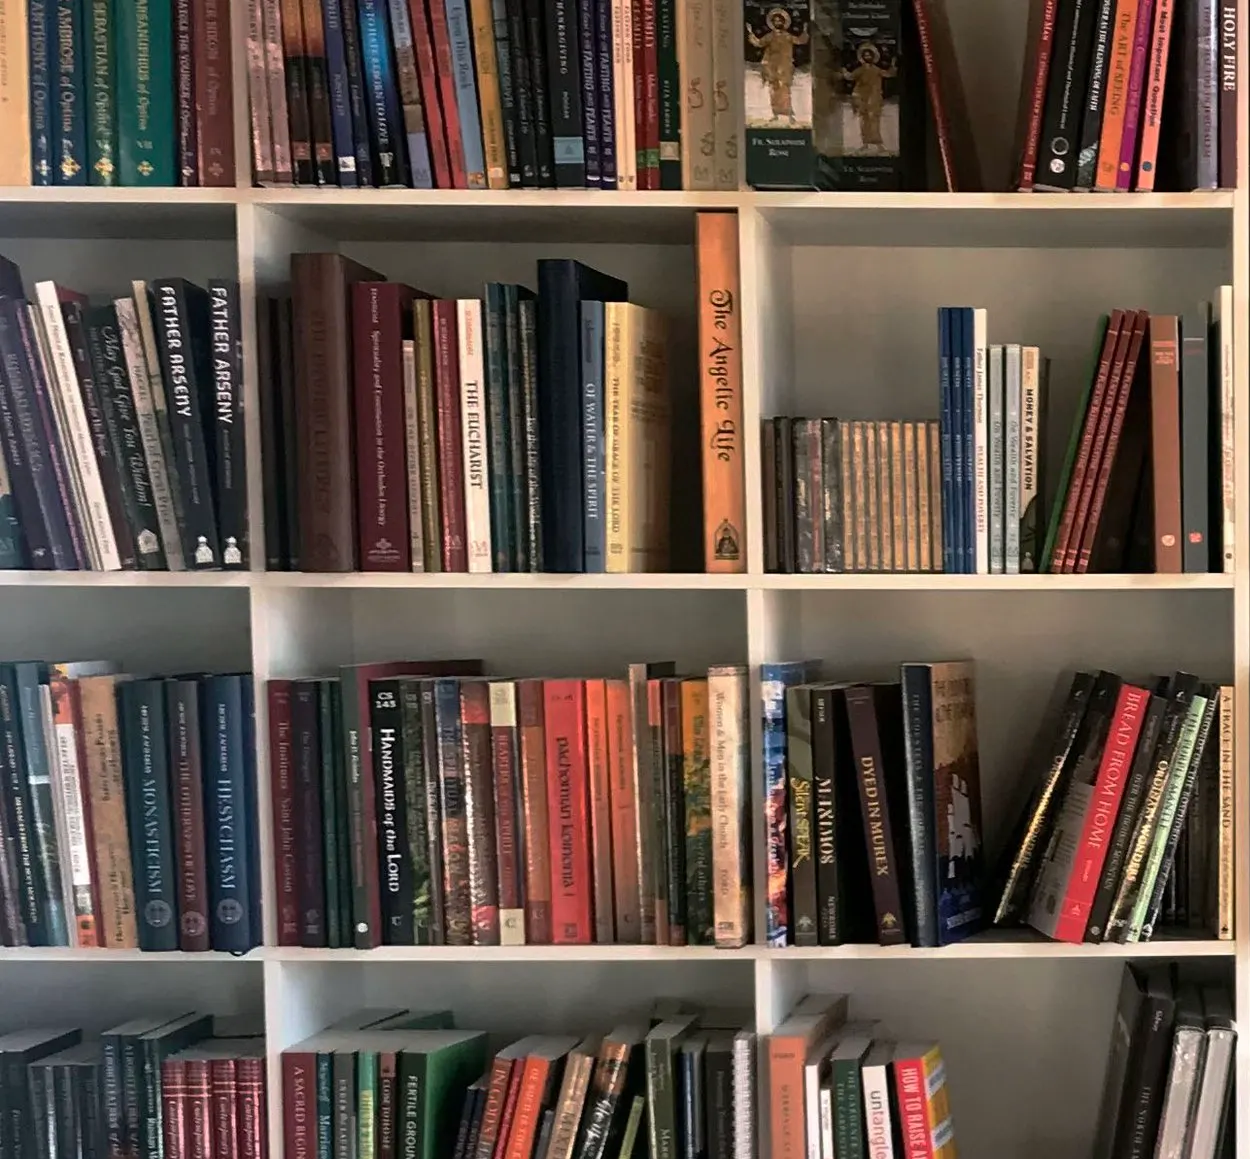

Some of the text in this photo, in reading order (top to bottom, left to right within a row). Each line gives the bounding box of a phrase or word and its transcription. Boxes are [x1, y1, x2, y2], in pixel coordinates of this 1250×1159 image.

[57, 7, 76, 132] AMBROSE of Optina
[1110, 13, 1130, 115] The ART of SEEING
[1223, 7, 1236, 91] HOLY FIRE
[212, 287, 229, 352] FATHER
[109, 366, 123, 390] God
[216, 359, 232, 424] ARSENY
[709, 289, 736, 462] The Angelic Life
[1025, 389, 1034, 424] MONEY
[465, 380, 482, 489] THE EUCHARIST
[1087, 693, 1141, 848] BREAD FROM HOME
[217, 779, 235, 888] HESYCHASM
[383, 814, 394, 826] of
[385, 829, 396, 851] the
[861, 757, 888, 876] DYED IN MUREX
[406, 1076, 417, 1117] FERTILE
[901, 1068, 919, 1094] HOW
[904, 1097, 921, 1111] TO
[907, 1115, 926, 1149] RAISE
